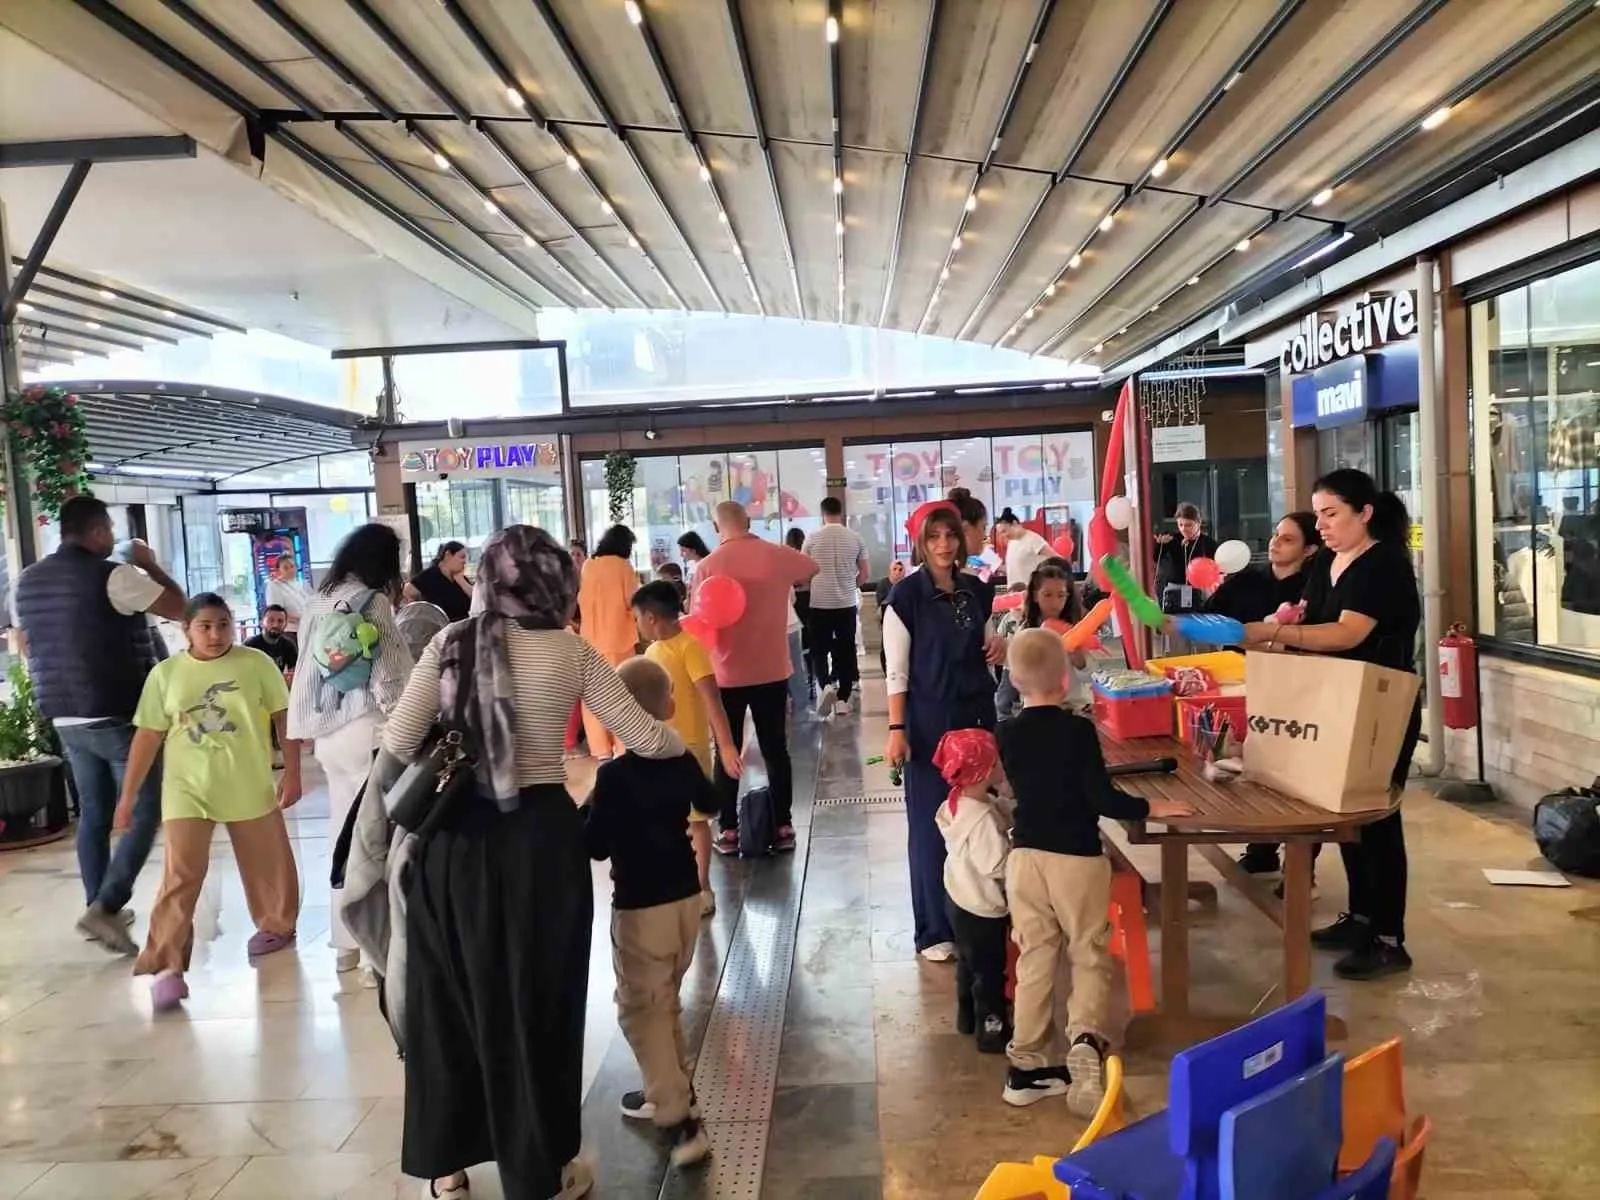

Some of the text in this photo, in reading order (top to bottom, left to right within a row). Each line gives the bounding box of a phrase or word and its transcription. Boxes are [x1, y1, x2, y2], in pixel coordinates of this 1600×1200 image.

[1280, 290, 1416, 374] collective
[1317, 370, 1362, 417] mavi
[423, 442, 537, 471] TOY PLAY
[866, 449, 938, 481] TOY
[995, 442, 1070, 474] TOY
[1005, 476, 1062, 497] PLAY
